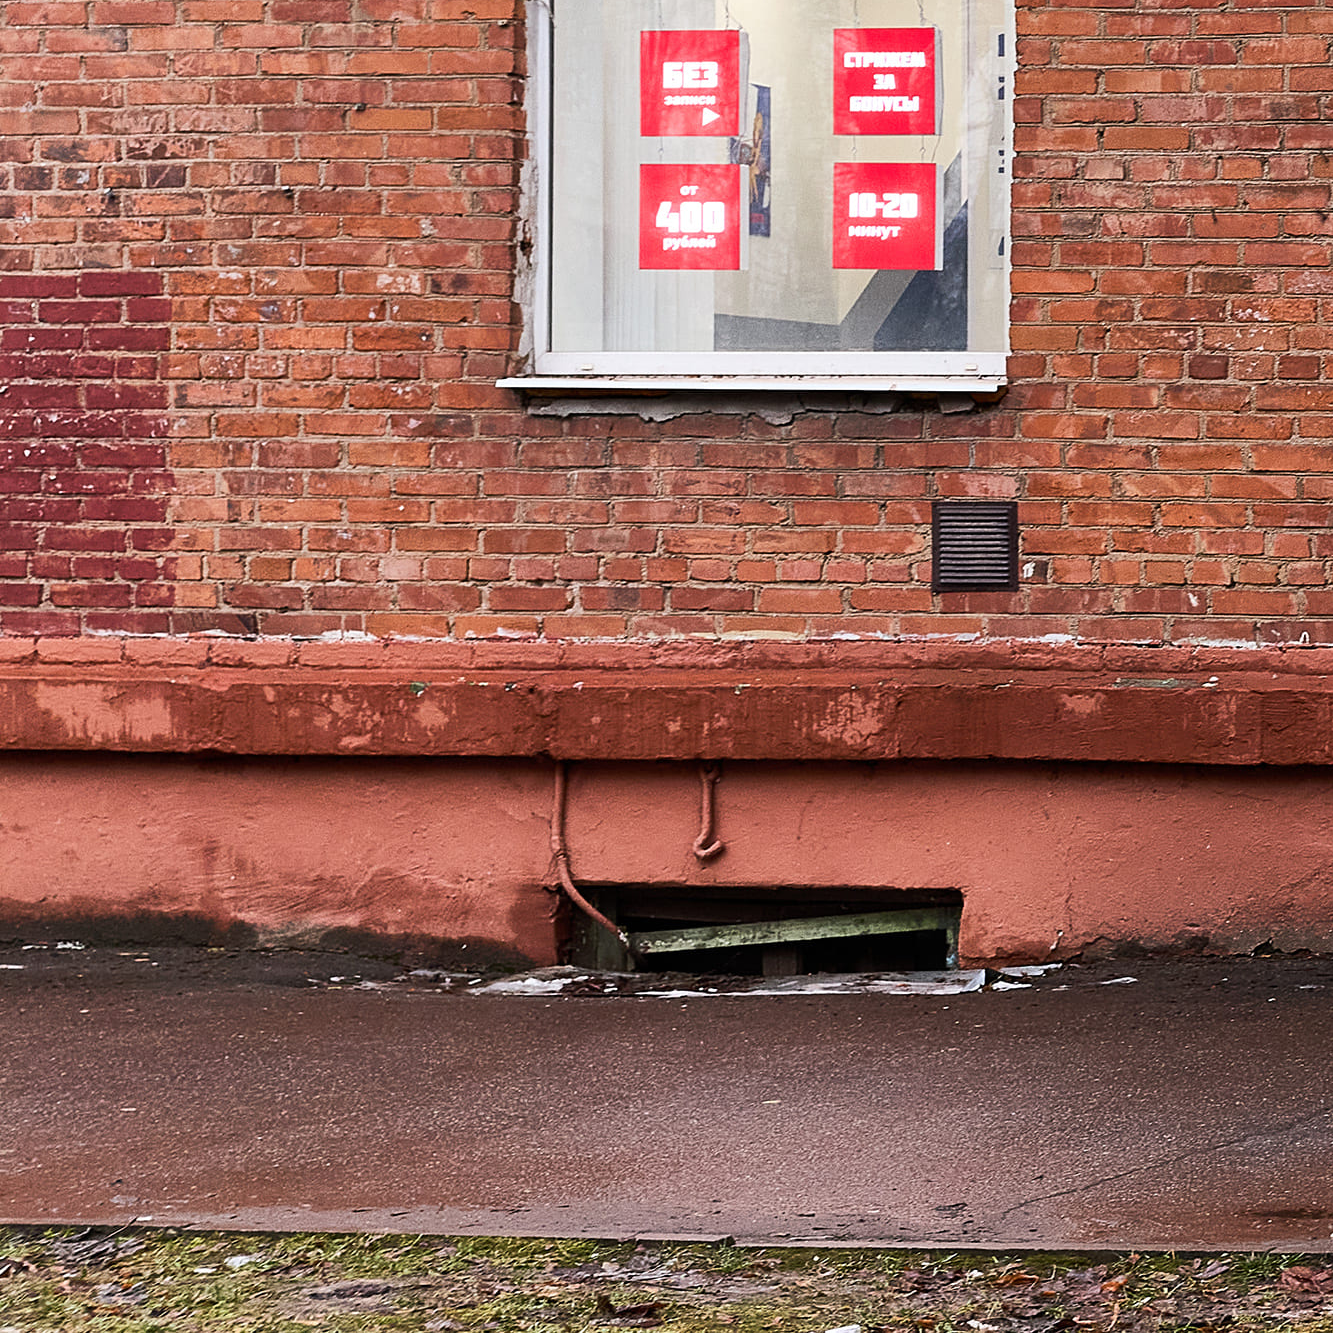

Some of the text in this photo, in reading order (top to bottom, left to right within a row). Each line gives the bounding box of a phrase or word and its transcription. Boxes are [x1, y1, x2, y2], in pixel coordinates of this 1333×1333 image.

[844, 52, 926, 67] СТРИЖЕМ
[663, 61, 718, 88] БЕЗ
[873, 74, 896, 89] ЗА
[664, 95, 716, 106] записи
[850, 96, 919, 112] БОНУСЫ
[680, 185, 699, 195] от
[849, 193, 918, 218] 10-20
[656, 201, 725, 233] 400
[848, 226, 901, 240] минут
[663, 235, 716, 251] рублей
